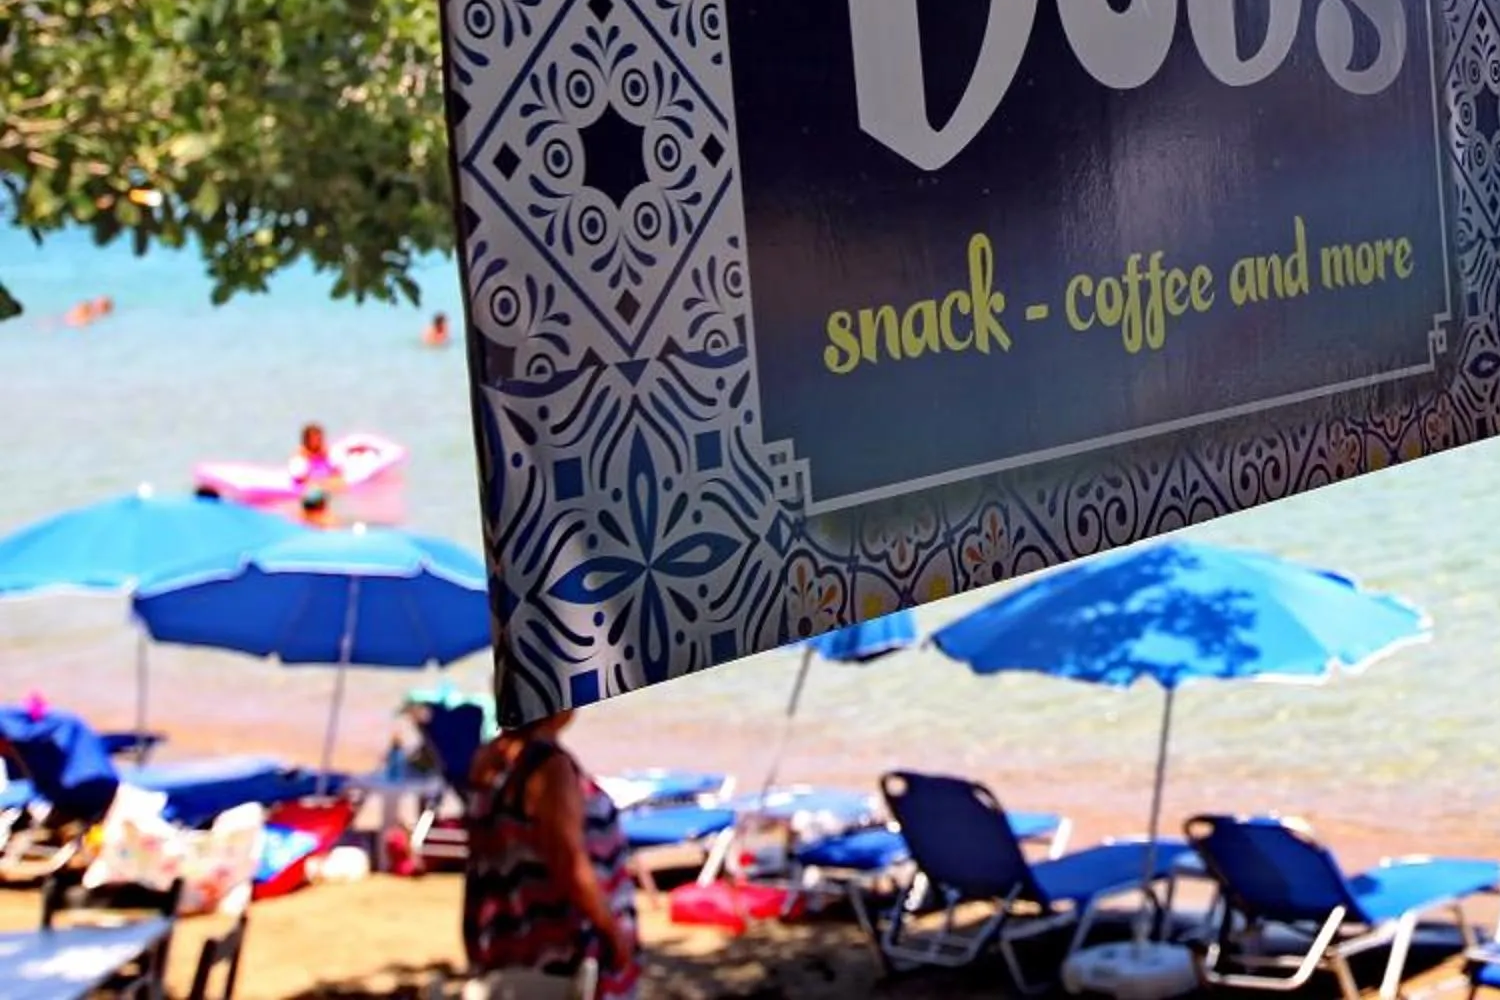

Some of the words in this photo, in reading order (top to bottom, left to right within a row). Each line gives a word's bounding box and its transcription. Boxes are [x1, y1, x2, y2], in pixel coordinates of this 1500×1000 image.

[823, 232, 1011, 374] snack
[1065, 250, 1215, 354] coffee
[1230, 215, 1310, 305] and
[1321, 231, 1414, 290] more
